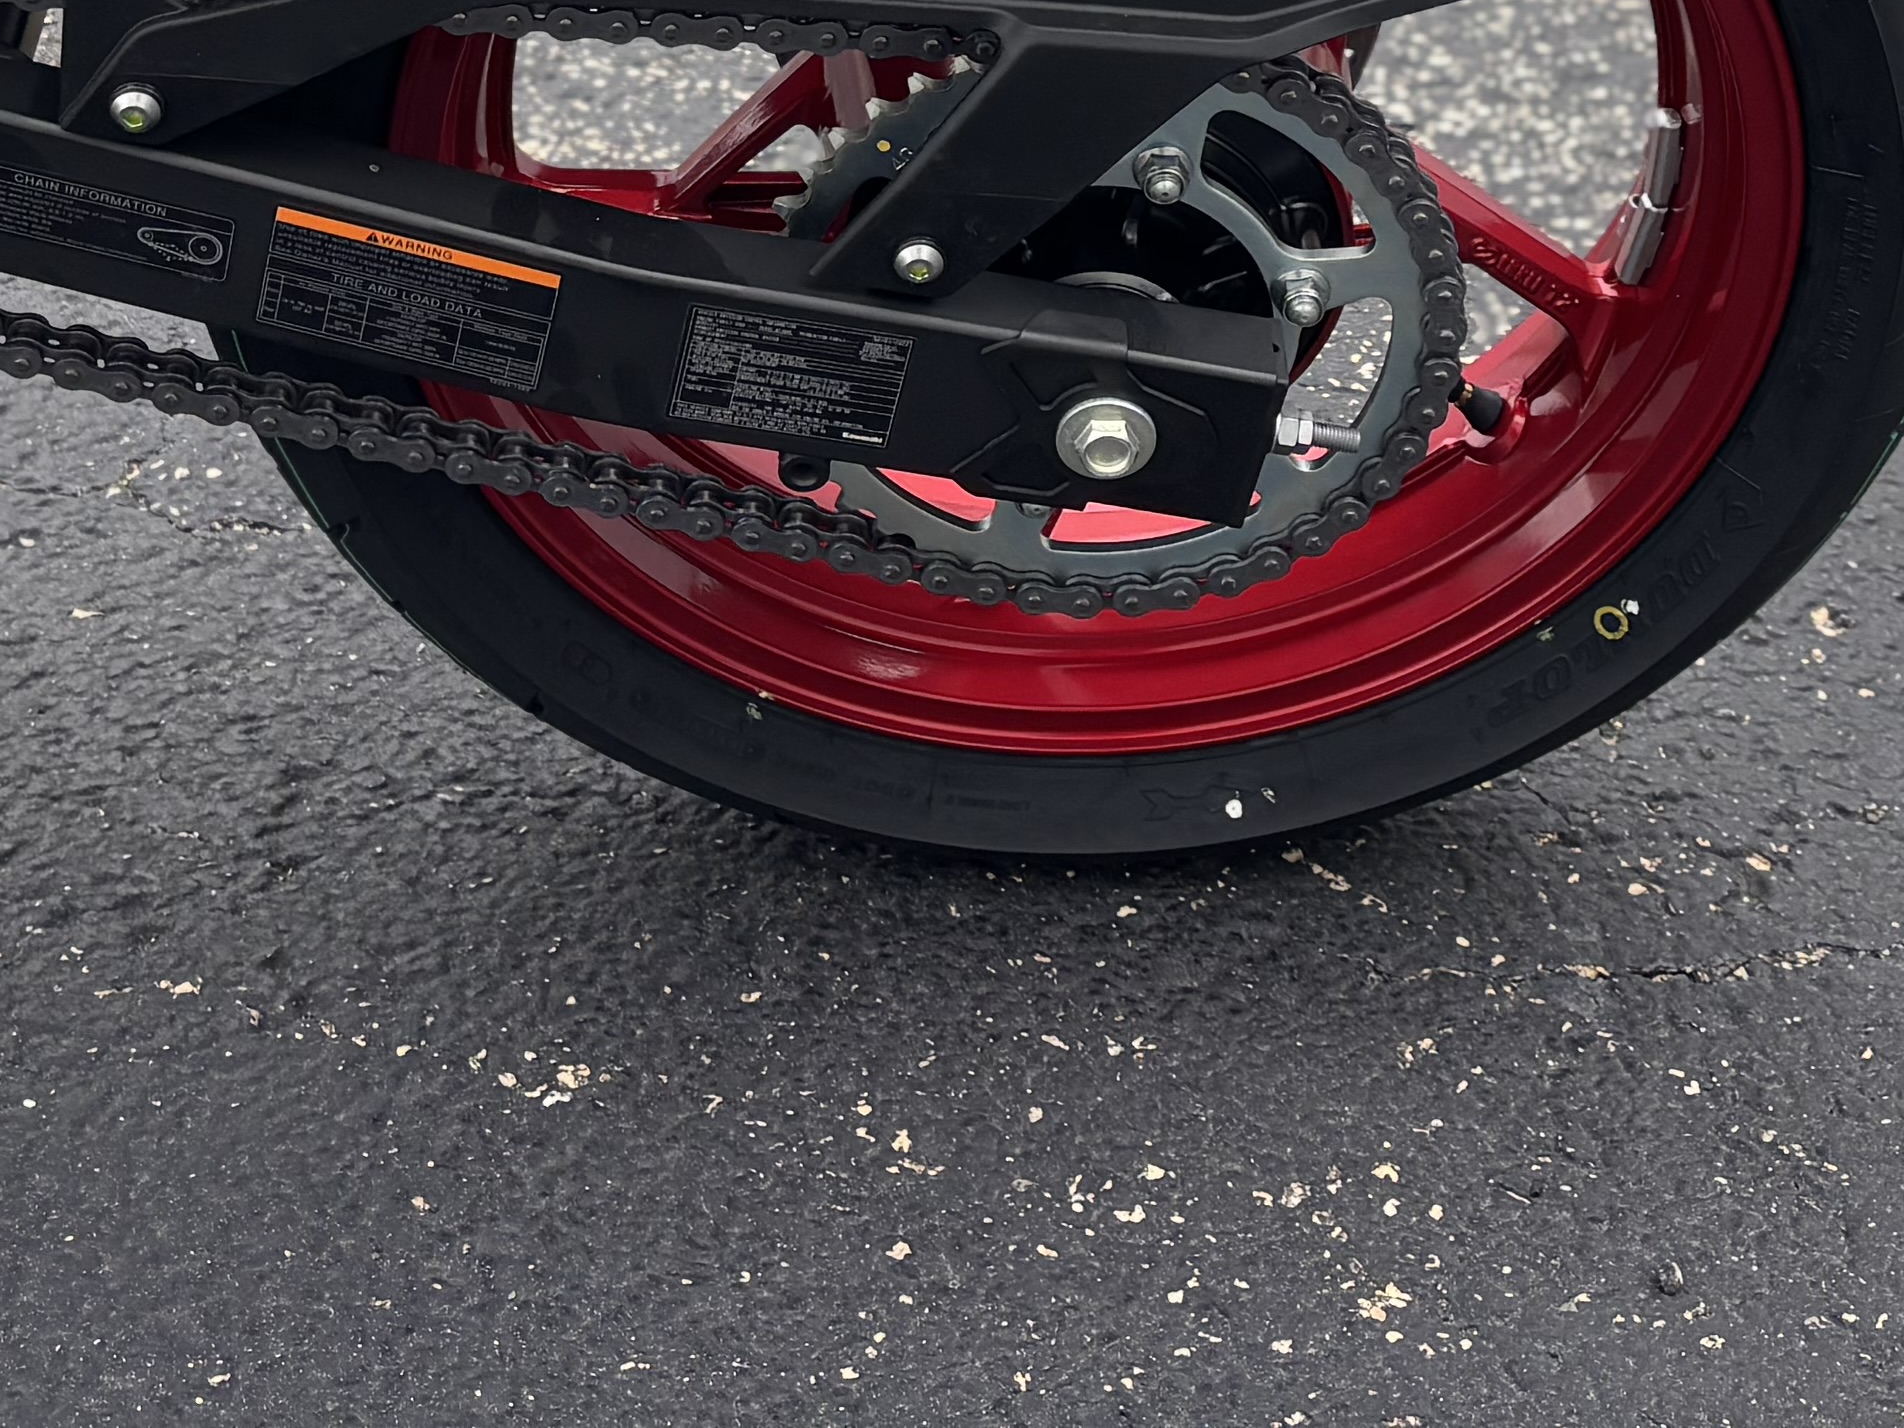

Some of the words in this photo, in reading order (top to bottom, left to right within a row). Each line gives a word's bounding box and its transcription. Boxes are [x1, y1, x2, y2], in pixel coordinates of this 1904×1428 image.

[13, 172, 61, 193] CHAIN
[64, 184, 169, 218] INFORMATION
[381, 233, 454, 261] WARNING
[331, 273, 364, 290] TIRE
[367, 282, 399, 298] AND
[402, 291, 442, 309] LOAD
[444, 301, 483, 319] DATA
